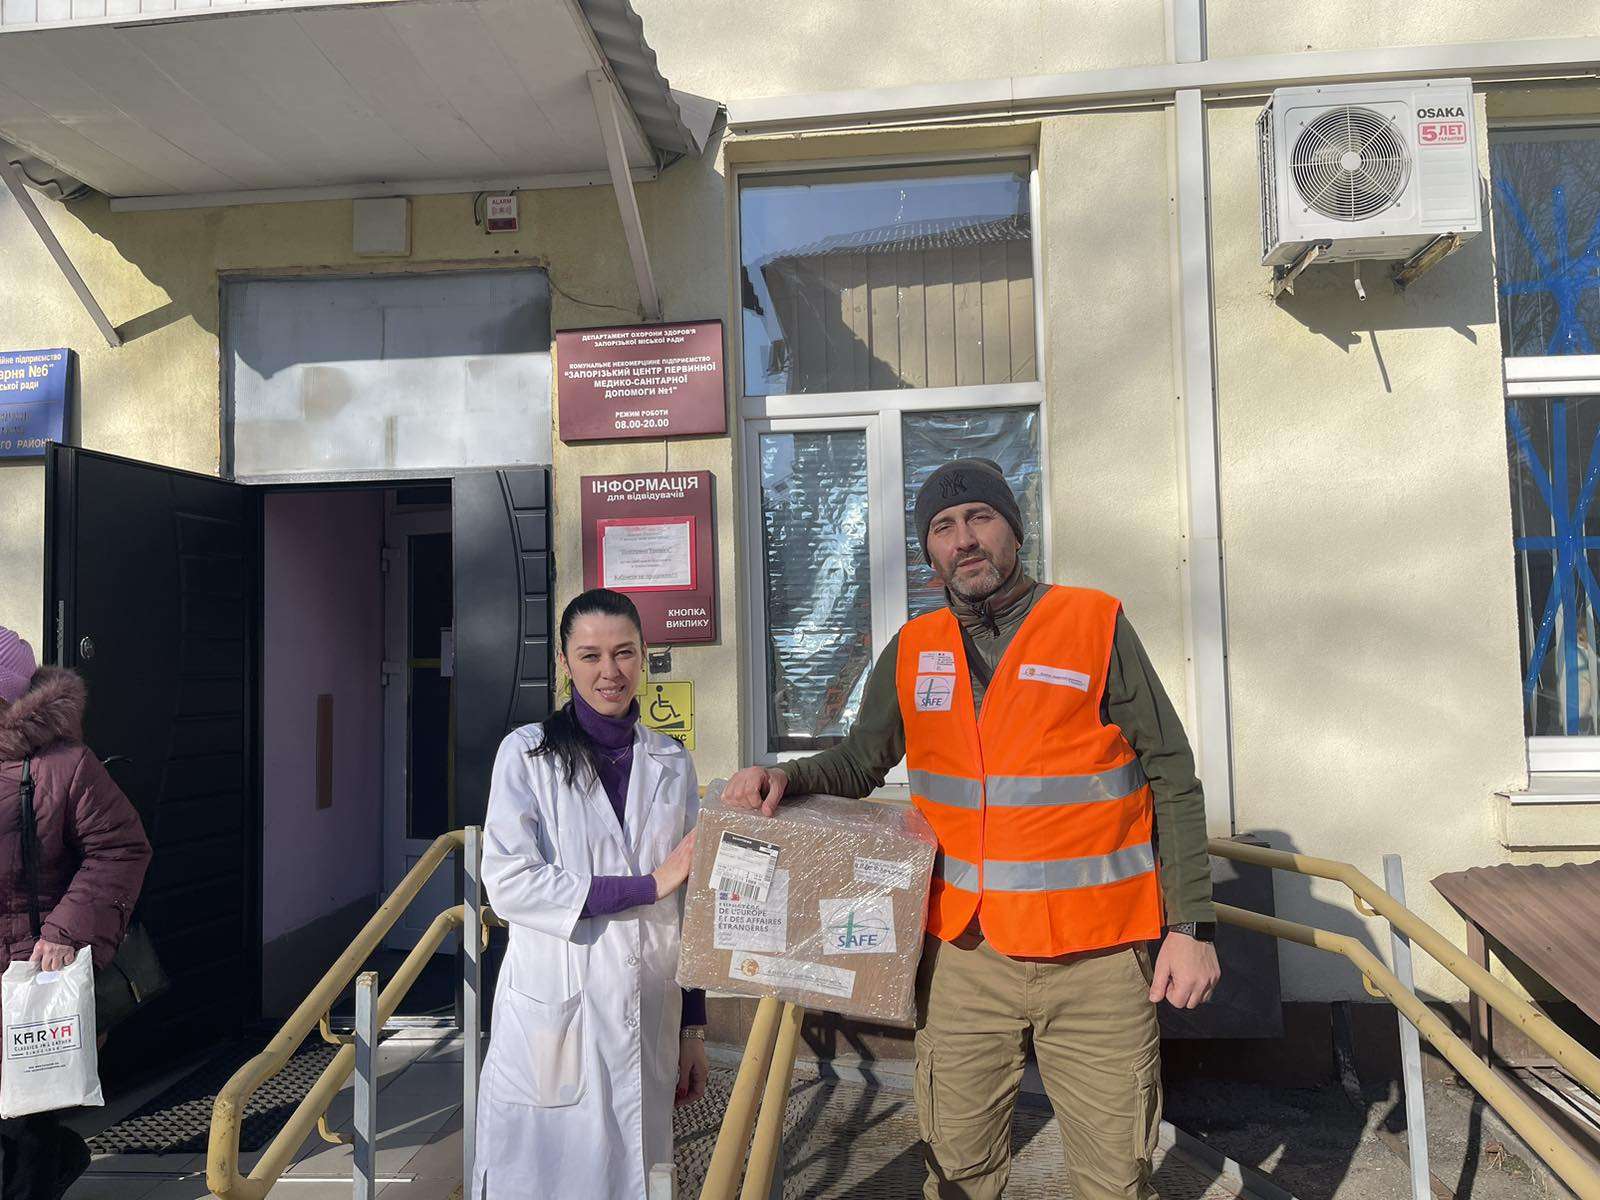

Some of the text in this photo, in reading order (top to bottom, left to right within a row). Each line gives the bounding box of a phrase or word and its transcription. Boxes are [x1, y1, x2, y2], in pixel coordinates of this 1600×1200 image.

[1417, 107, 1464, 118] OSAKA
[1422, 125, 1463, 141] 5 ЛЕТ
[582, 333, 629, 341] ДЕПАРТАМЕНТ
[594, 336, 684, 348] ЗАПОРІЗЬКОЇ МІСЬКОЇ РАДИ
[15, 354, 61, 365] підприємство
[569, 355, 711, 370] КОМУНАЛЬНЕ НЕКОМЕРЦІЙНЕ ПІДПРИЄМСТВО
[632, 366, 662, 377] ЦЕНТР
[664, 362, 716, 374] ПЕРВИННОЇ
[20, 380, 39, 392] ради
[594, 375, 688, 388] МЕДИКО-САНІТАРНОЇ
[604, 389, 656, 399] ДОПОМОГИ
[615, 408, 669, 418] РЕЖИМ РОБОТИ
[615, 418, 669, 430] 08.00-20.00
[592, 476, 699, 494] ІНФОРМАЦІЯ
[607, 491, 685, 502] для відвідувачів
[668, 607, 706, 617] КНОПКА
[666, 619, 709, 629] ВИКЛИКУ
[920, 697, 943, 707] SAFE
[731, 908, 768, 917] L'EUROPE
[730, 916, 745, 924] DES
[747, 917, 782, 926] AFFAIRES
[838, 934, 878, 947] SAFE
[14, 1026, 72, 1045] KARYA
